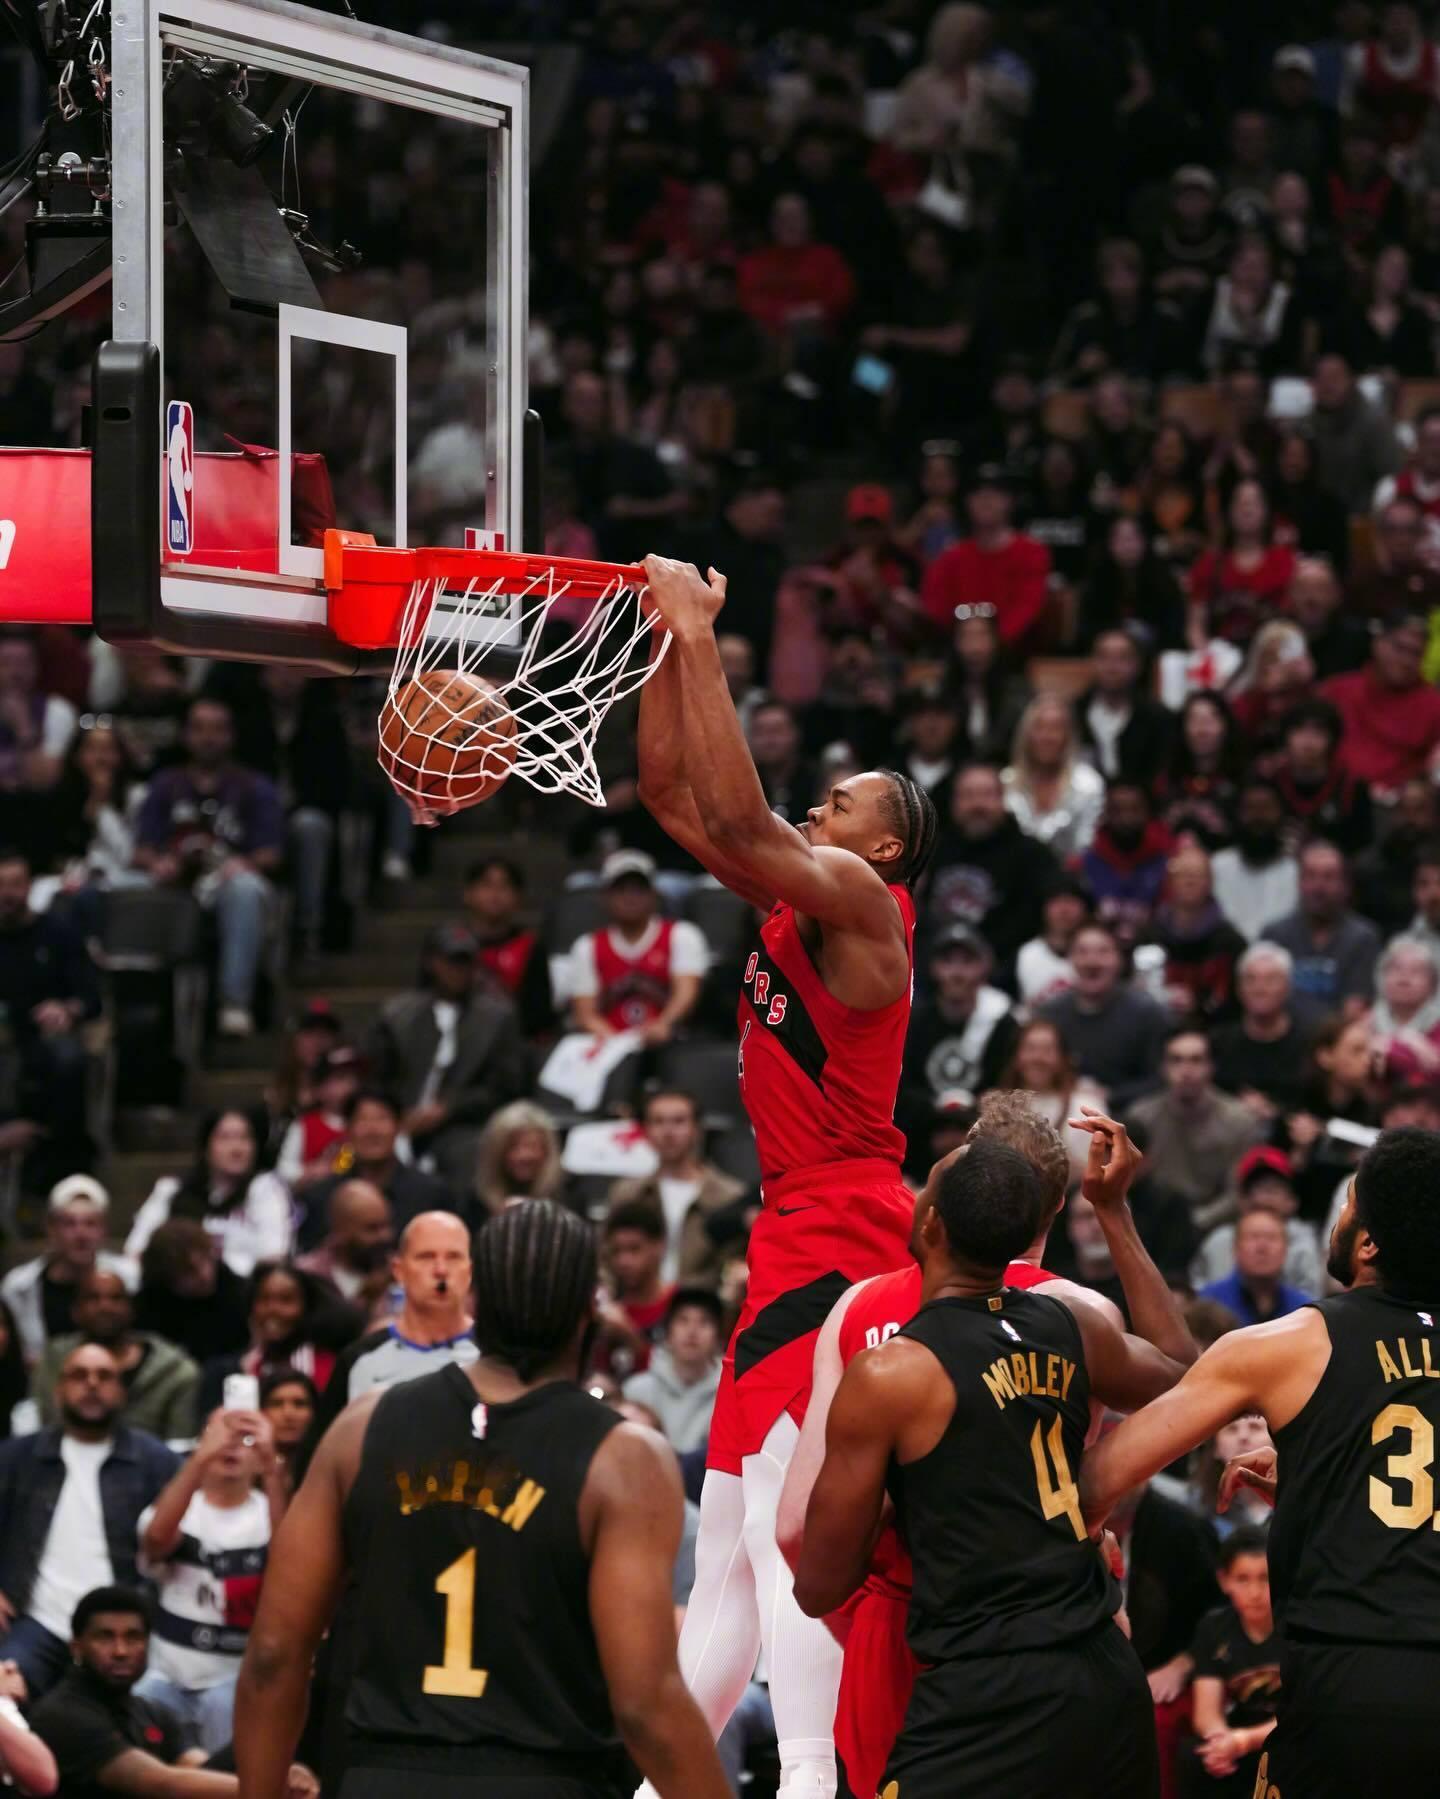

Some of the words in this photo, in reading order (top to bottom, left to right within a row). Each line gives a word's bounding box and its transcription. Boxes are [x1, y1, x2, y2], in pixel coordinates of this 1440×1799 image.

[171, 519, 184, 544] NBA
[981, 1351, 1077, 1410] MOBLEY
[1375, 1337, 1440, 1384] ALL
[1031, 1411, 1088, 1542] 4
[1369, 1404, 1440, 1532] 3
[422, 1547, 489, 1697] 1
